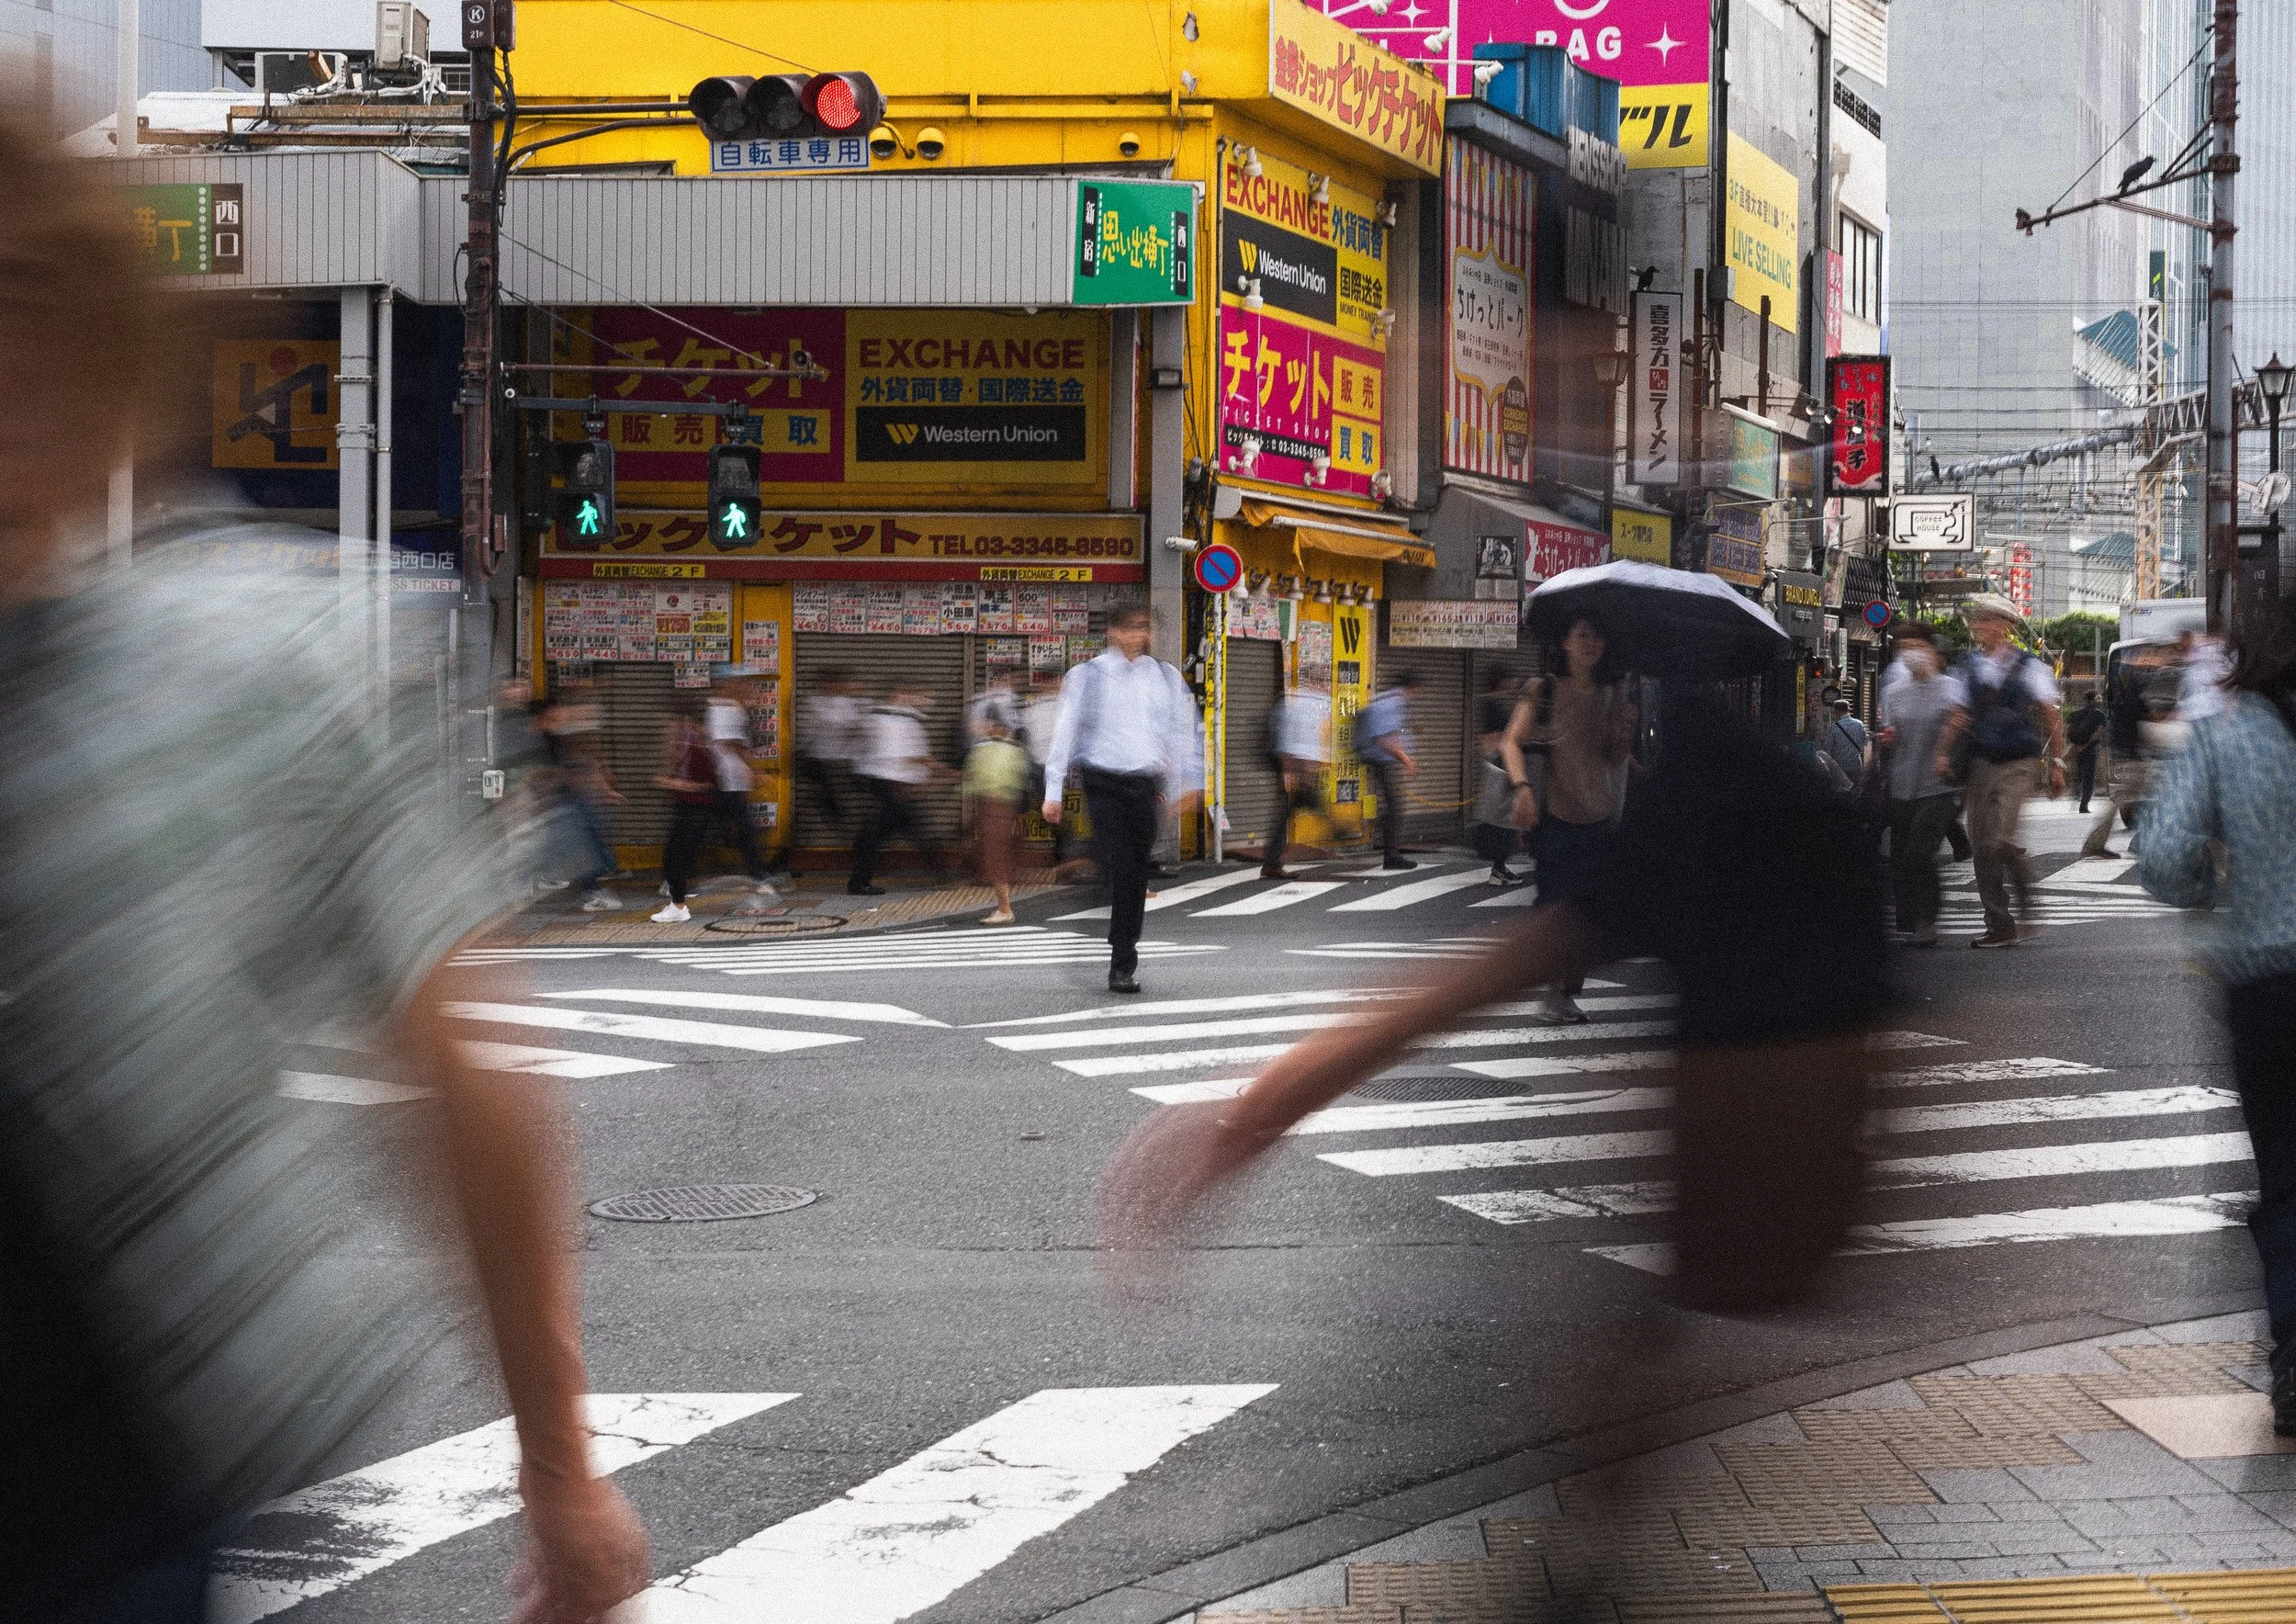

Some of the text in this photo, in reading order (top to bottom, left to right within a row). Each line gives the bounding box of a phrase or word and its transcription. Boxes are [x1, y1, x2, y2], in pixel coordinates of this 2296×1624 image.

[1336, 40, 1443, 166] ビックチケット
[720, 138, 861, 167] 自転車専用
[1226, 163, 1329, 239] EXCHANGE
[215, 200, 239, 257] 西口
[1084, 199, 1095, 263] 新宿
[1101, 209, 1170, 276] 思い出横丁
[1331, 205, 1384, 262] 外貨両替
[1176, 223, 1187, 283] 西口
[1259, 248, 1326, 295] Western Union
[1732, 227, 1792, 290] LIVE SELLING
[1339, 301, 1356, 315] MONEY
[1340, 265, 1383, 310] 国際送金
[1458, 284, 1524, 339] ちけっとパーク
[859, 338, 1086, 368] EXCHANGE
[1649, 304, 1670, 367] 喜多方
[609, 337, 829, 398] チケット
[1224, 329, 1331, 421] チケット
[1341, 368, 1374, 410] 販売
[621, 414, 704, 445] 販売
[924, 425, 1058, 443] Western Union
[1223, 405, 1331, 441] TICKET SHOP
[1339, 425, 1374, 466] 買取
[1649, 392, 1669, 471] ラーメン
[555, 517, 921, 554] ックケット
[928, 535, 974, 556] TEL
[631, 567, 668, 578] EXCHANGE
[982, 569, 1018, 581] 外貨両替
[1018, 569, 1055, 580] EXCHANGE
[943, 607, 974, 618] 小田原
